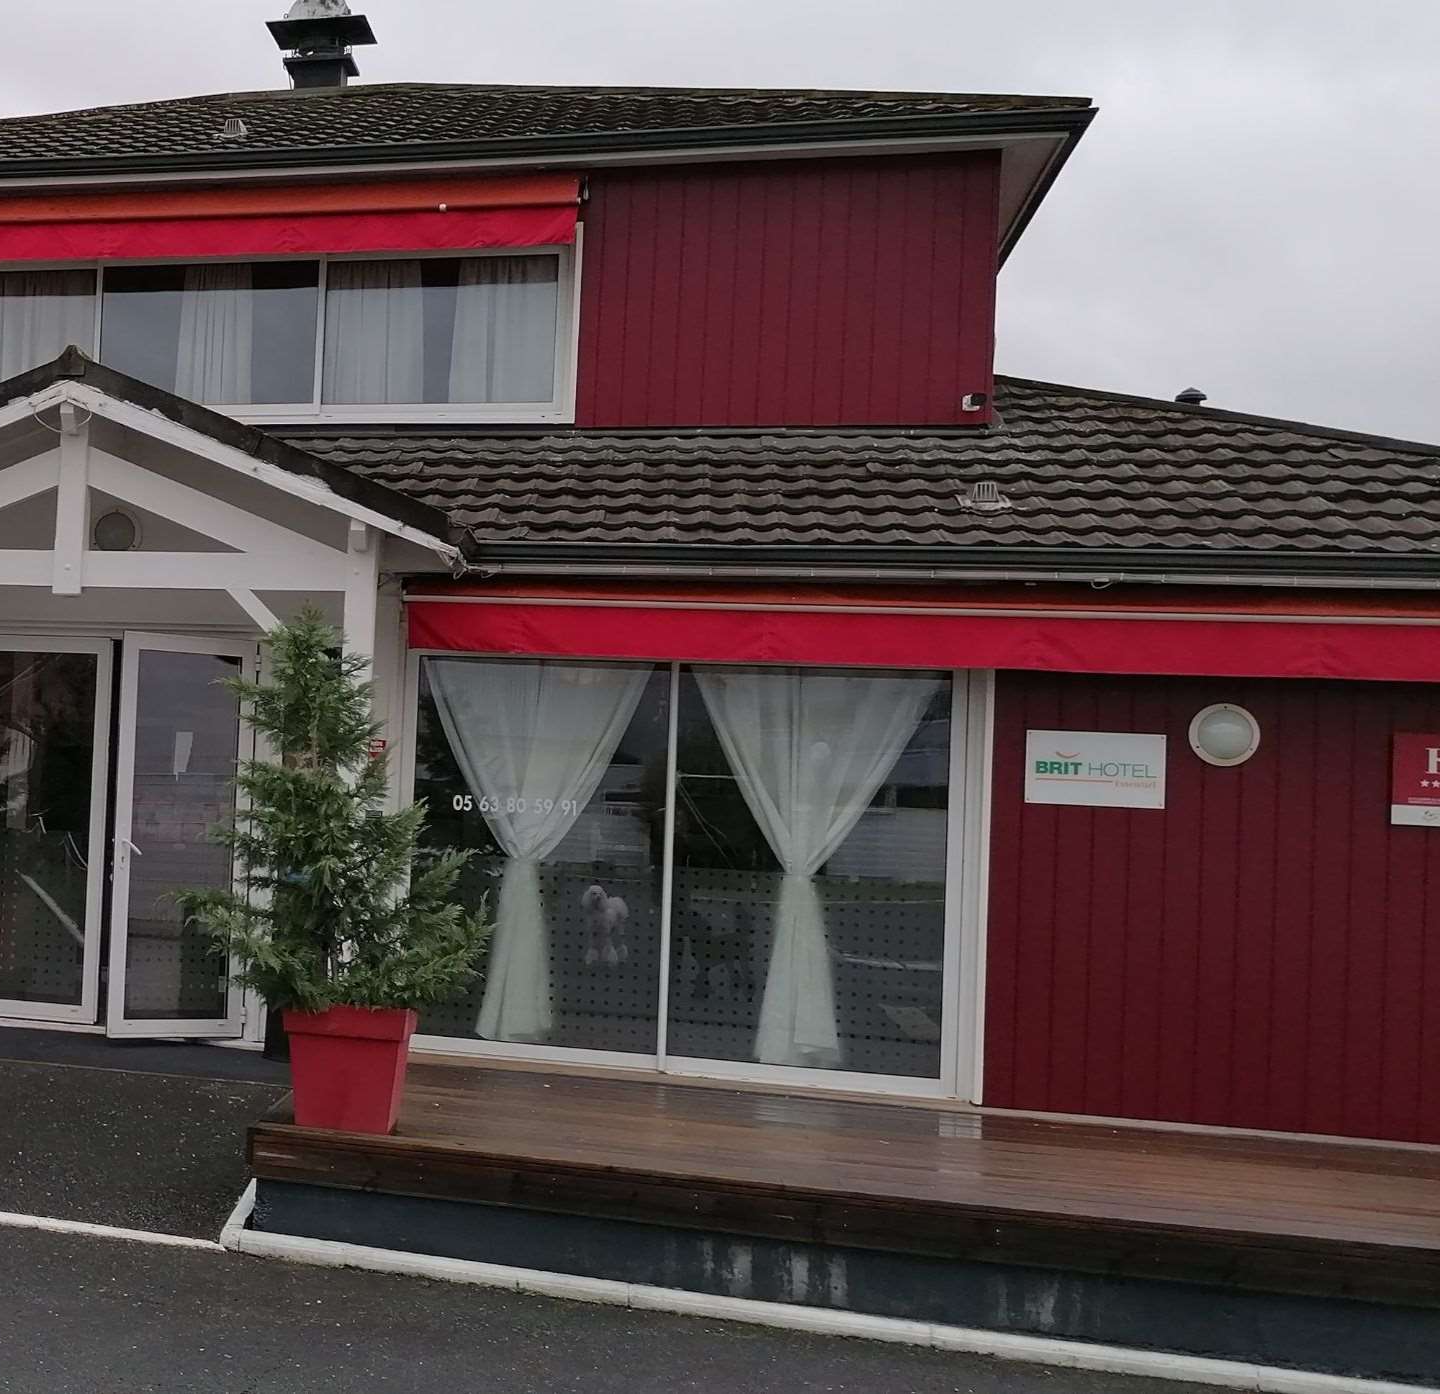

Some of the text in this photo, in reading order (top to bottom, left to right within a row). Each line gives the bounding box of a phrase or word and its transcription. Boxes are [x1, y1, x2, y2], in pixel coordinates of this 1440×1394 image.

[1035, 761, 1157, 778] BRIT HOTEL
[453, 795, 577, 816] 05 63 80 59 91
